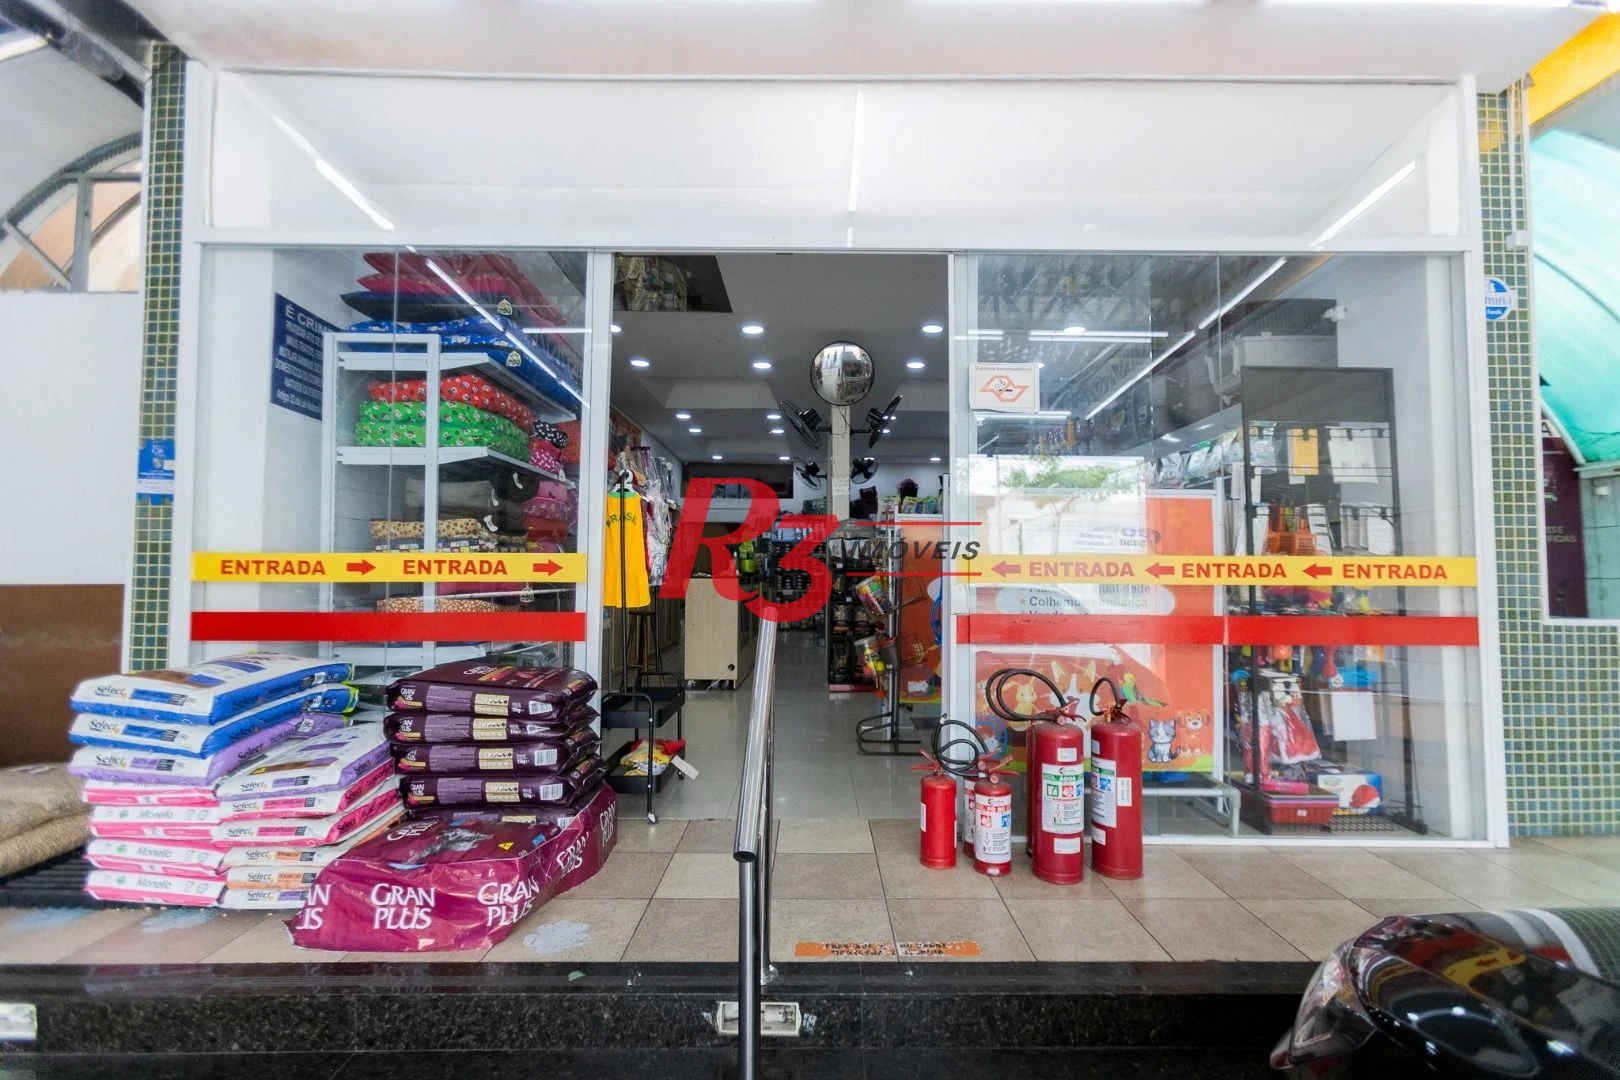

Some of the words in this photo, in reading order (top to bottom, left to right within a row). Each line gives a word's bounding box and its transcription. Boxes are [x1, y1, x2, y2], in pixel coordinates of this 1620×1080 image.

[220, 559, 326, 576] ENTRADA
[402, 559, 508, 576] ENTRADA
[1029, 561, 1135, 577] ENTRADA
[1182, 563, 1287, 578] ENTRADA
[1342, 564, 1448, 580] ENTRADA
[370, 883, 436, 908] GRAN
[477, 875, 540, 906] GRAN
[372, 907, 433, 930] PLUS
[486, 896, 536, 928] PLUS
